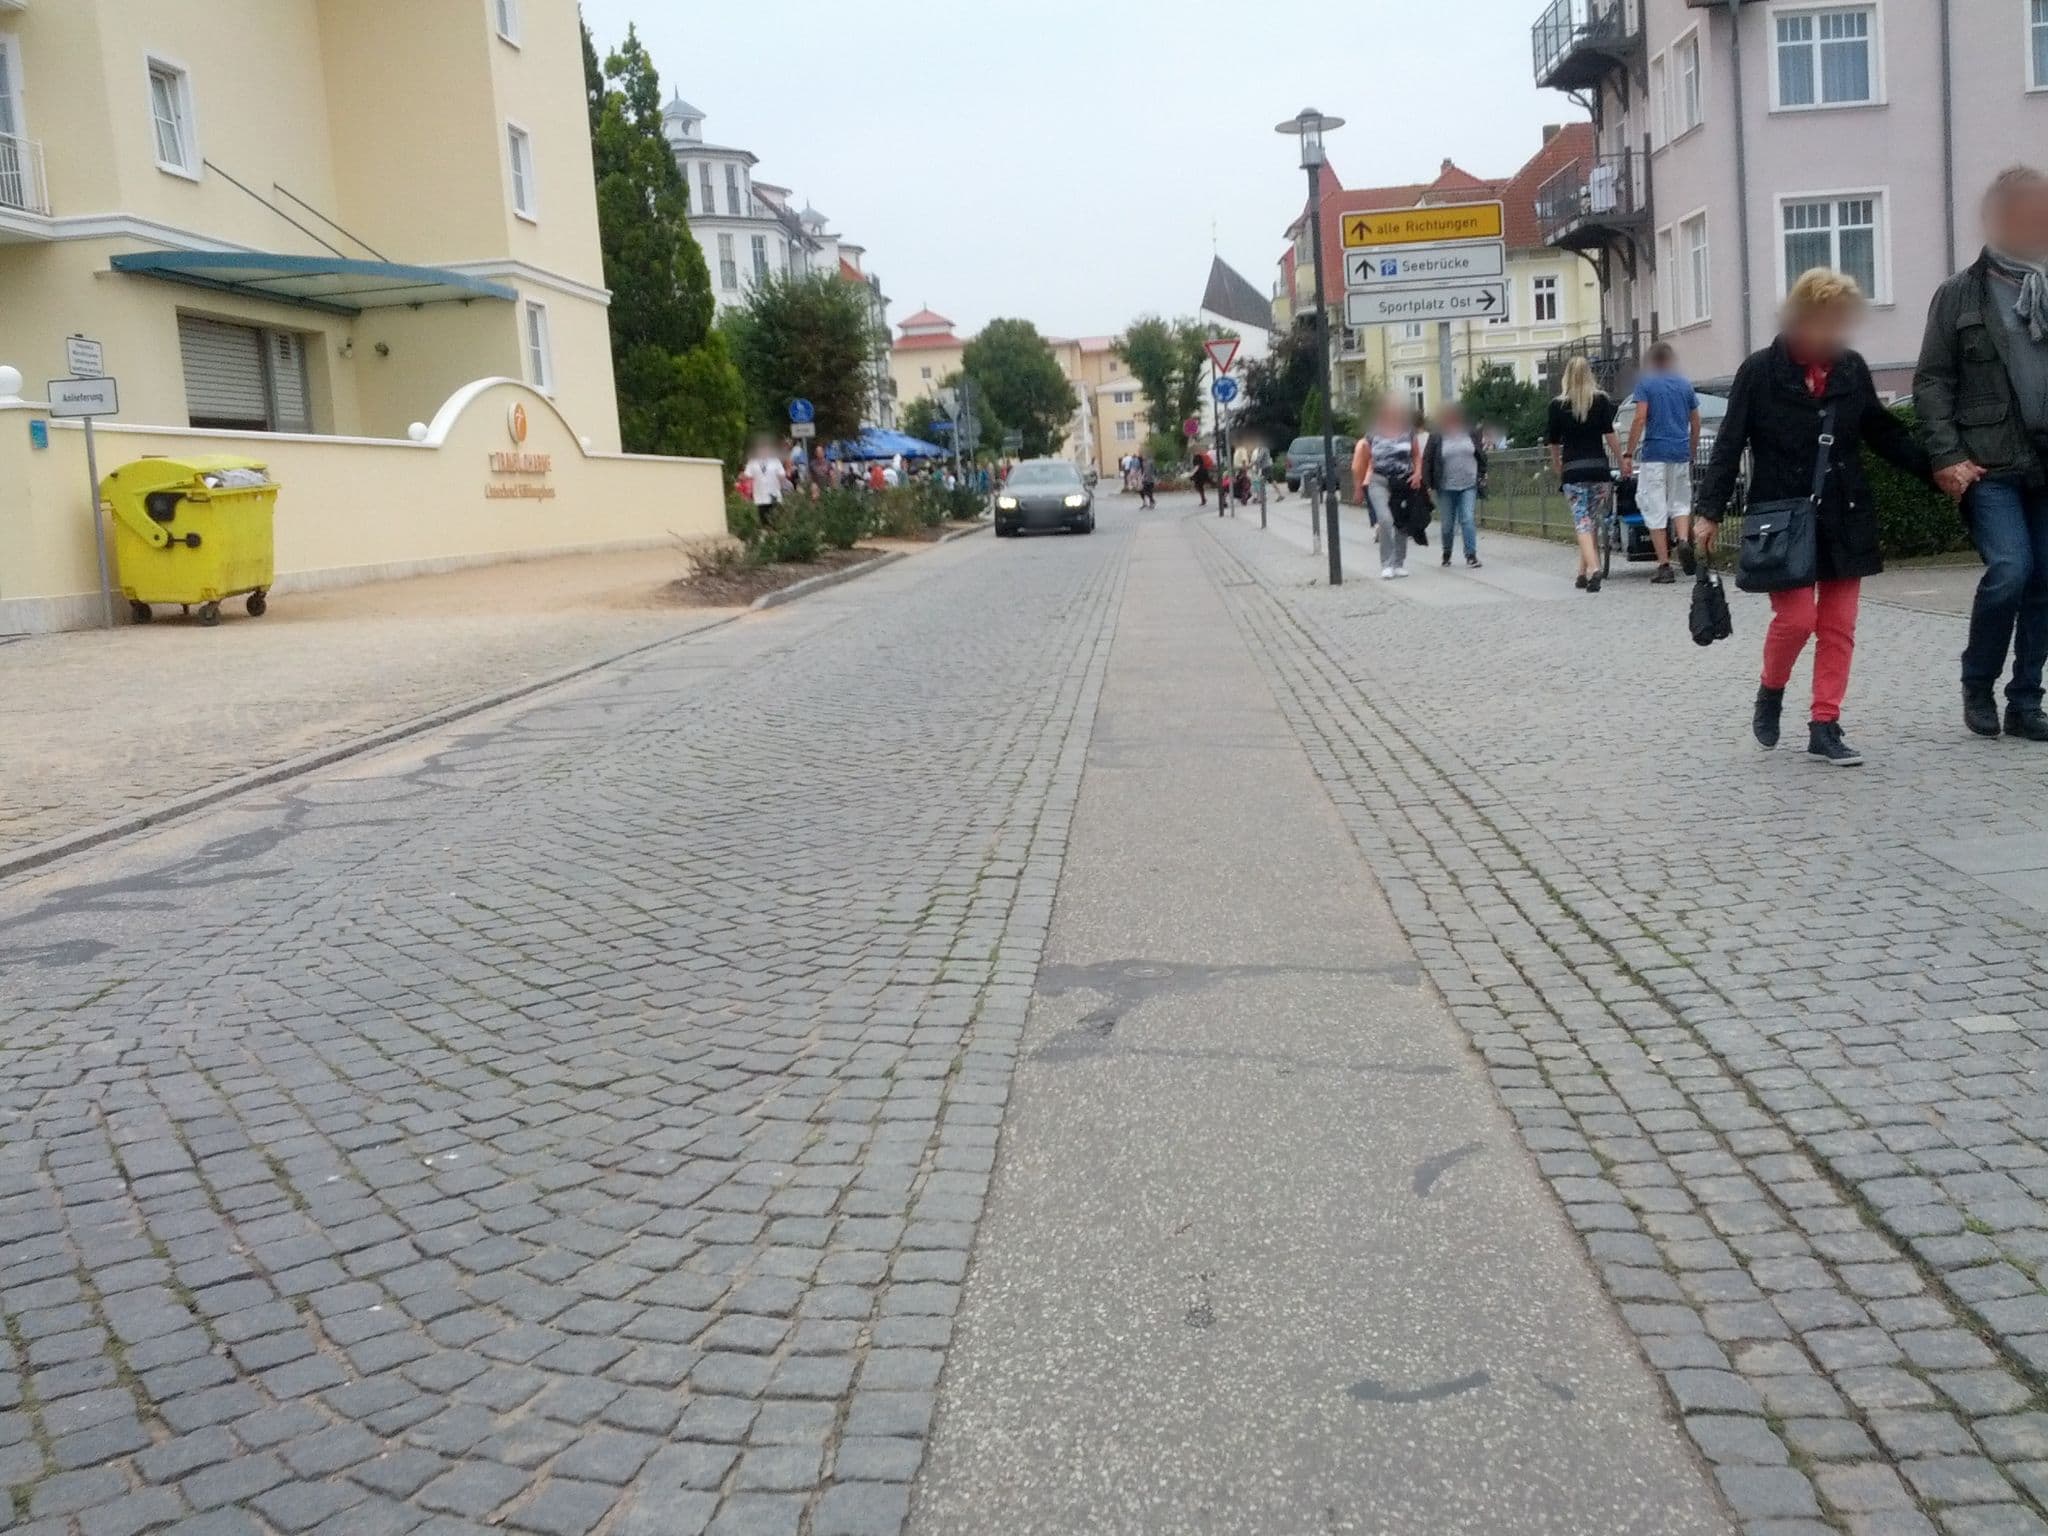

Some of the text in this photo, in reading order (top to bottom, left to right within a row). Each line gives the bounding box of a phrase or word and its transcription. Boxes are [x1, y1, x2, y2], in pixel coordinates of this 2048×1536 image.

[1376, 216, 1478, 234] alle Richtungen
[1402, 256, 1469, 272] Seebrücke
[1378, 296, 1471, 315] Sportplatz Ost
